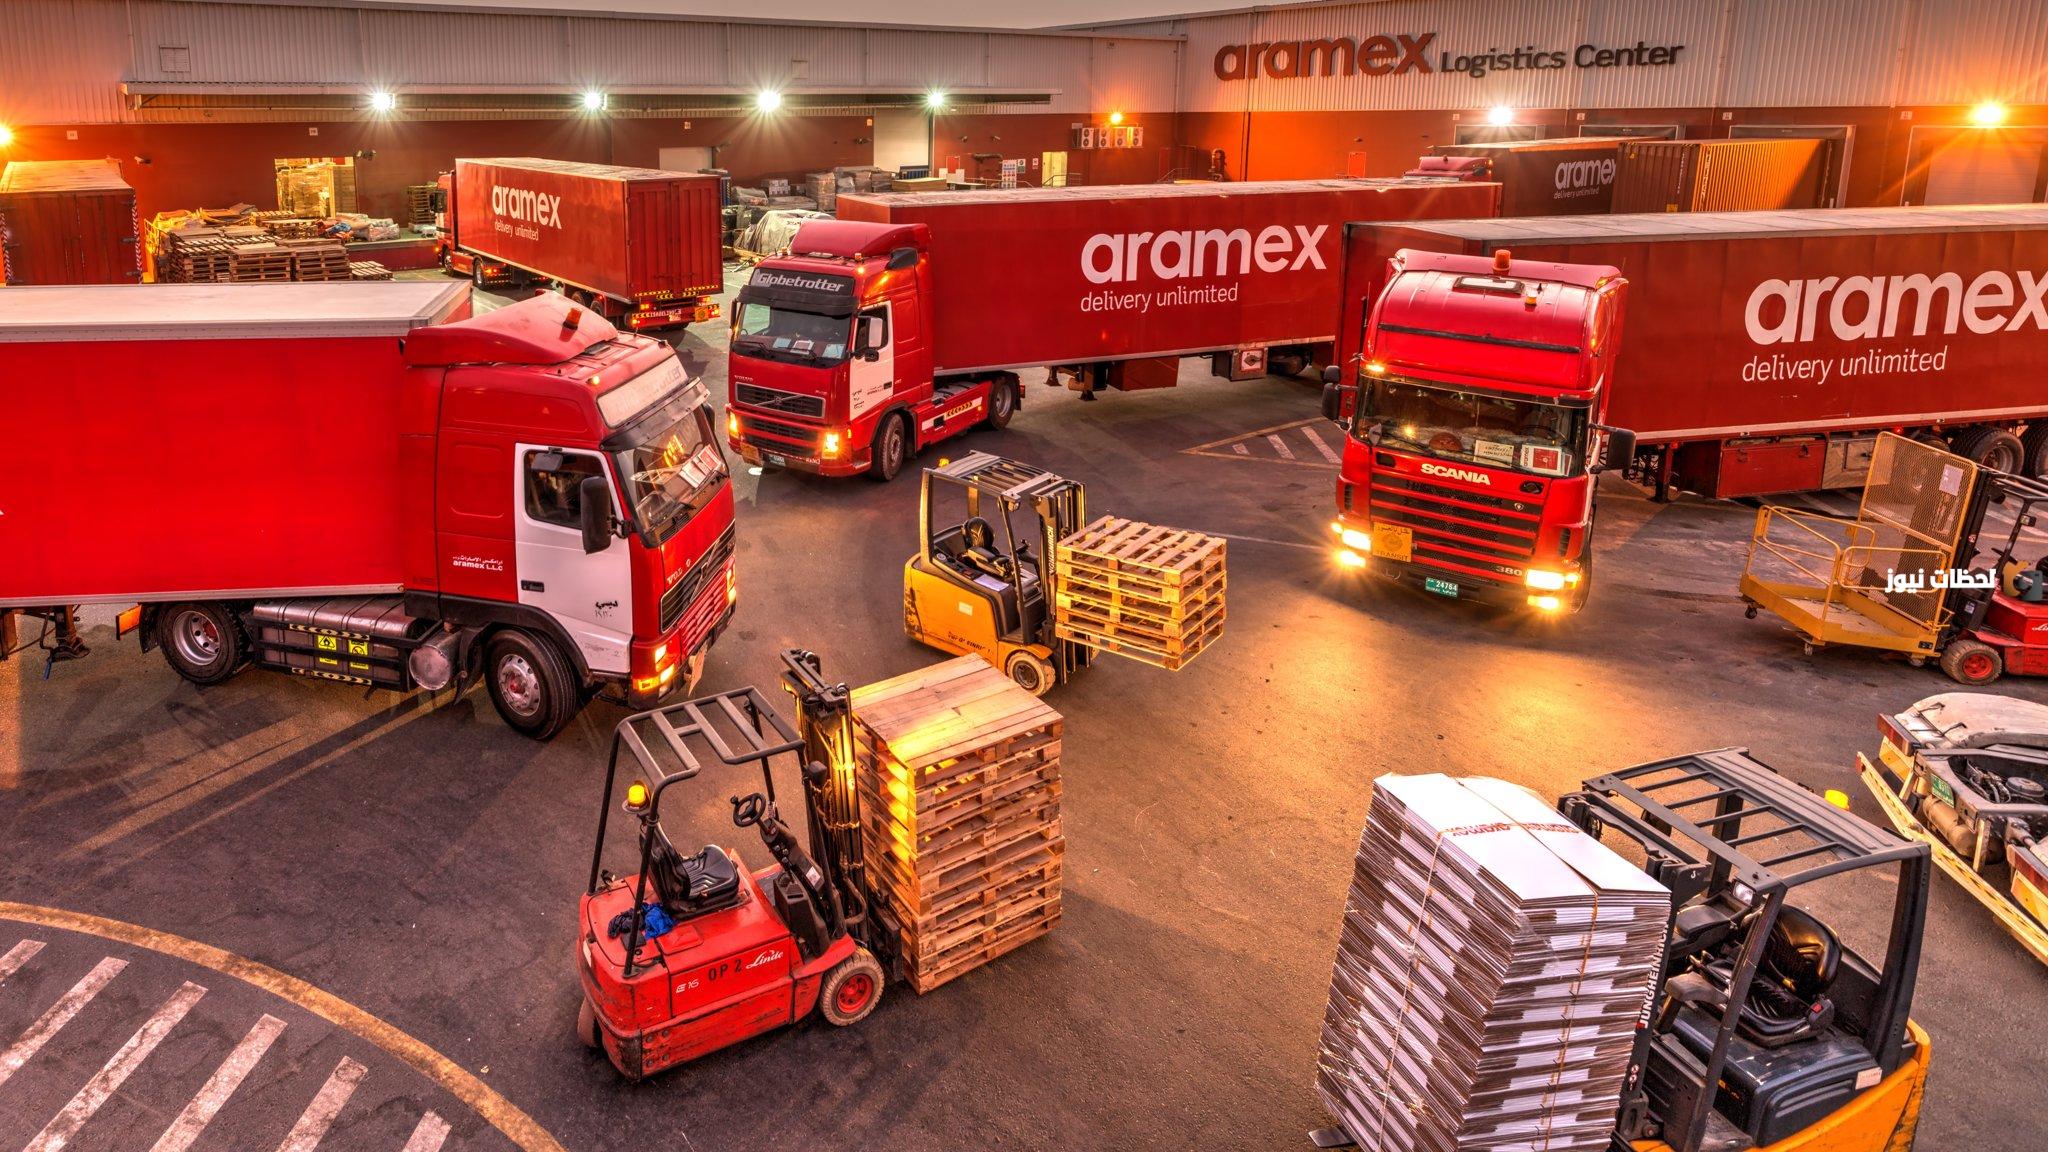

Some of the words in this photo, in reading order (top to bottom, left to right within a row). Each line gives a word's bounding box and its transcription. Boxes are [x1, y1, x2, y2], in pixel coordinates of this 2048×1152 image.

[1214, 33, 1436, 81] aramex
[1441, 46, 1566, 78] Logistics
[1575, 41, 1685, 68] Center
[1553, 190, 1575, 199] delivery
[1576, 187, 1599, 196] unlimited
[492, 185, 562, 229] aramex
[495, 219, 513, 237] delivery
[515, 224, 539, 241] unlimited
[1081, 225, 1328, 284] aramex
[758, 273, 844, 292] Globetrotter
[1081, 290, 1151, 313] delivery
[1157, 282, 1239, 306] unlimited
[1745, 270, 2048, 345] aramex
[1742, 354, 1833, 385] delivery
[1840, 345, 1948, 377] unlimited
[1420, 463, 1491, 485] SCANIA
[453, 560, 485, 569] aramex
[1496, 565, 1523, 577] 380
[746, 950, 784, 969] Linde
